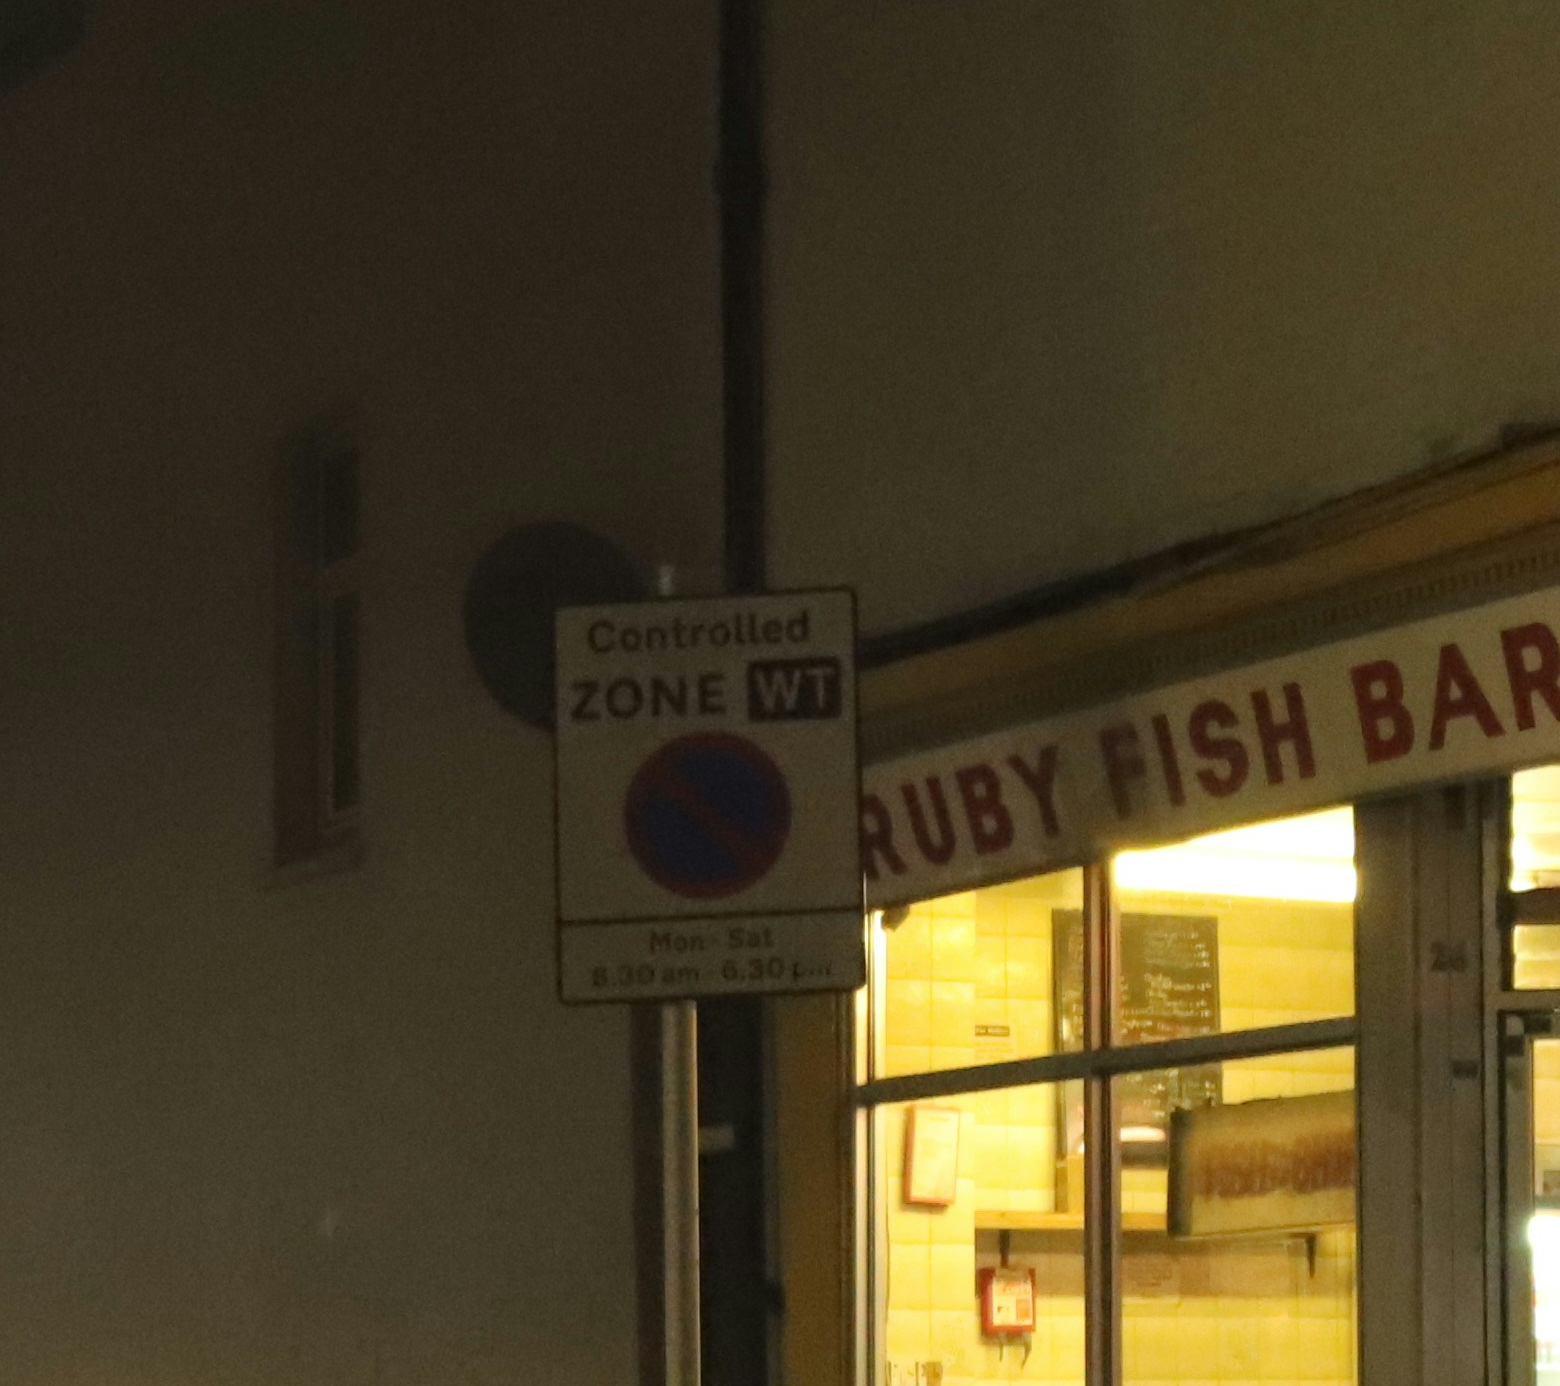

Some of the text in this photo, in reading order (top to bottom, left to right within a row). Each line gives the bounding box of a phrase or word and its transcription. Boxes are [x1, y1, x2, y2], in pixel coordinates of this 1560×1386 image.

[587, 611, 811, 655] Controlled
[570, 666, 833, 722] ZONE WT
[861, 744, 1063, 881] RUBY
[1099, 681, 1317, 820] FISH
[649, 926, 775, 956] Mon Sat
